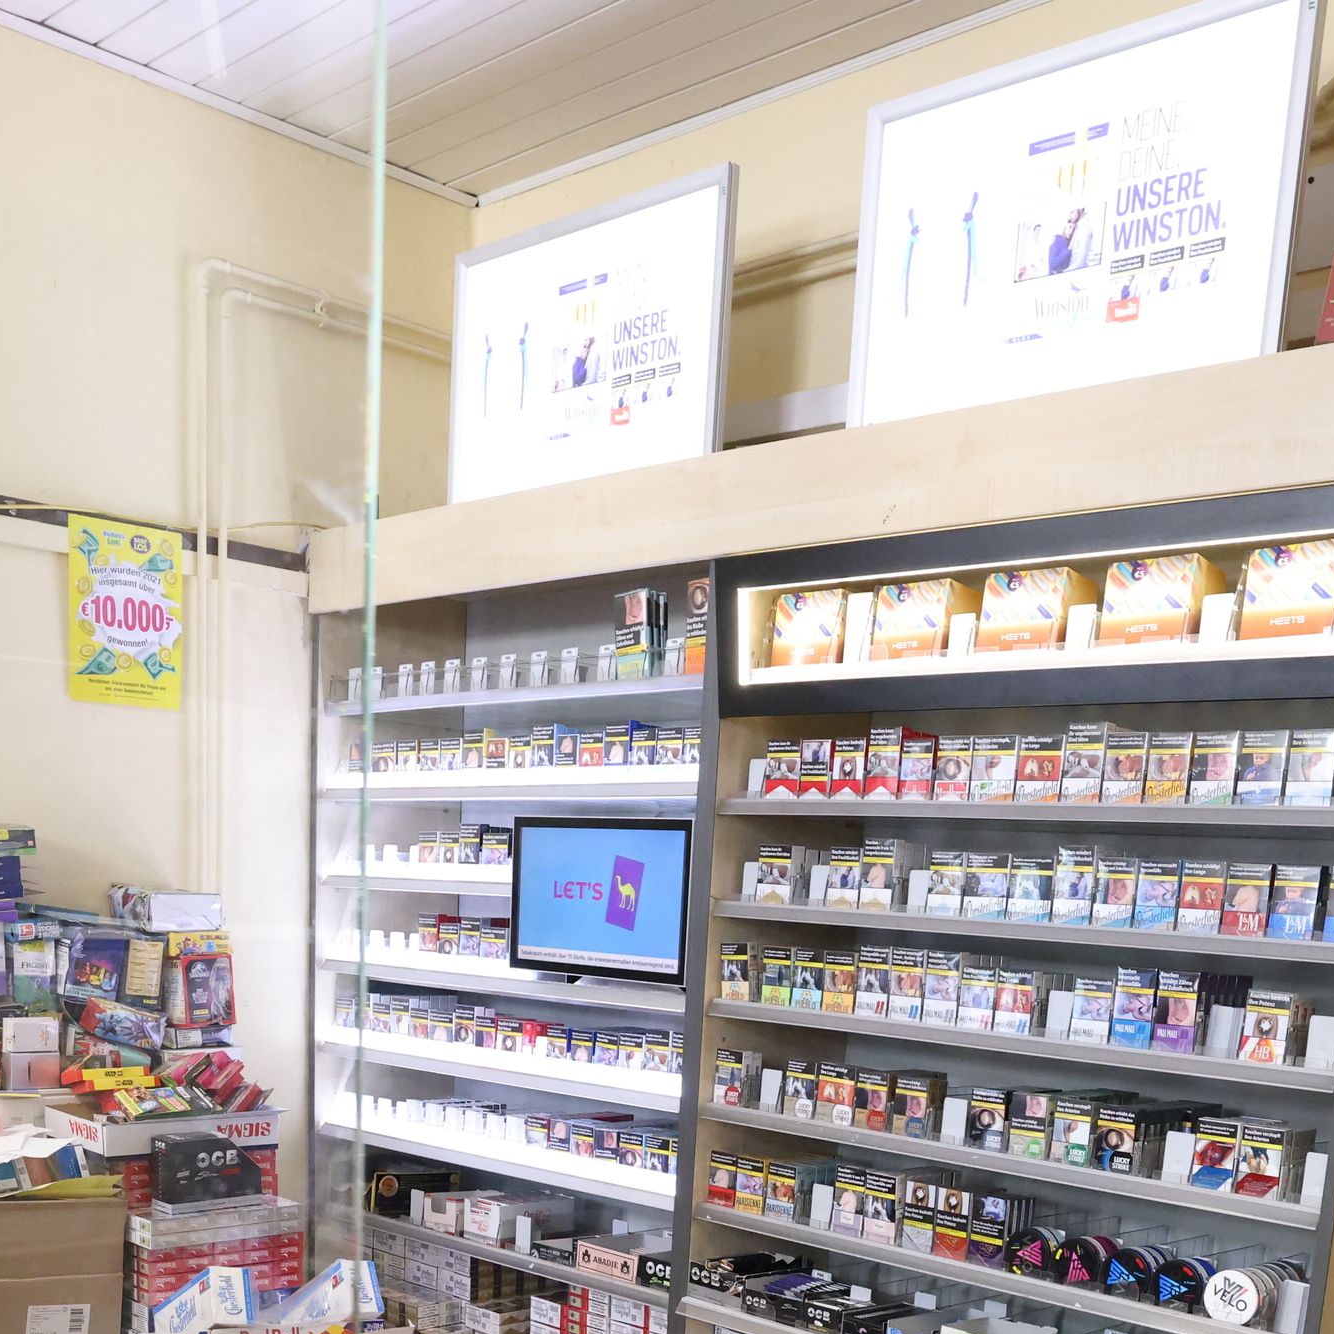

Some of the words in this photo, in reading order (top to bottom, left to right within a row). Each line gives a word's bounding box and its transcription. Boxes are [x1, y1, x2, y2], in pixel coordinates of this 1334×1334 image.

[1116, 168, 1207, 216] UNSERE
[1113, 200, 1226, 252] WINSTON.
[613, 310, 668, 345] UNSERE
[612, 336, 681, 372] WINSTON.
[91, 567, 108, 575] Hier
[110, 567, 141, 577] wurden
[143, 571, 161, 585] 2021
[99, 579, 137, 590] insgesamt
[139, 580, 155, 594] über
[1126, 624, 1157, 634] HEETS
[1270, 616, 1305, 625] HEETS
[107, 635, 148, 647] gewonnen!
[554, 881, 603, 900] LET'S
[1254, 1045, 1269, 1060] HB
[196, 1150, 238, 1168] OCB
[1112, 1162, 1130, 1171] STRIKE
[1113, 1156, 1130, 1165] LUCKY
[691, 1266, 720, 1289] OCB
[1214, 1285, 1247, 1312] VELO
[808, 1307, 830, 1323] OCB
